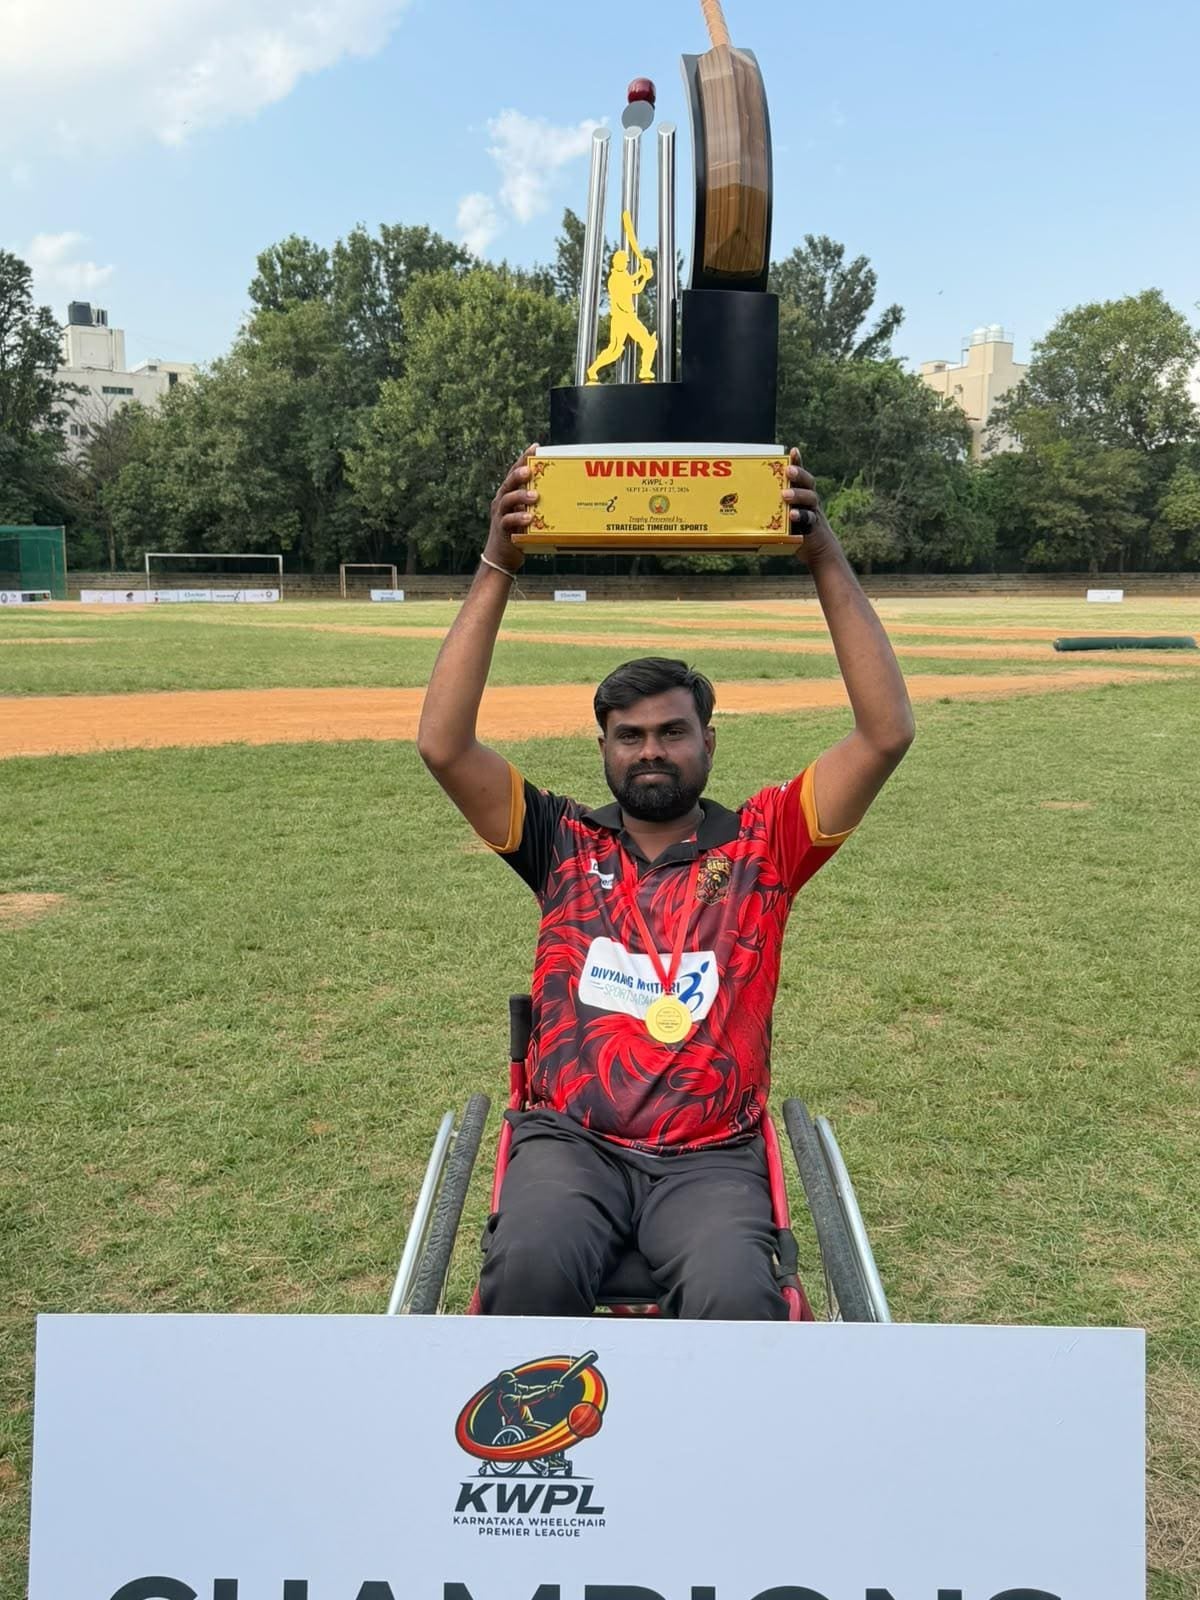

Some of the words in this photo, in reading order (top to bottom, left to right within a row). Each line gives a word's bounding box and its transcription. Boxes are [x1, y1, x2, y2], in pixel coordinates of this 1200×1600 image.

[584, 460, 733, 478] WINNERS
[606, 523, 645, 532] STRATEGIC
[647, 523, 678, 532] TIMEOUT
[680, 523, 709, 532] SPORTS
[590, 965, 634, 989] DIVYANG
[454, 1482, 605, 1514] KWPL
[453, 1516, 524, 1526] KARNATAKA
[529, 1517, 606, 1527] WHEELCHAIR
[478, 1527, 530, 1536] PREMIER
[535, 1528, 581, 1537] LEAGUE
